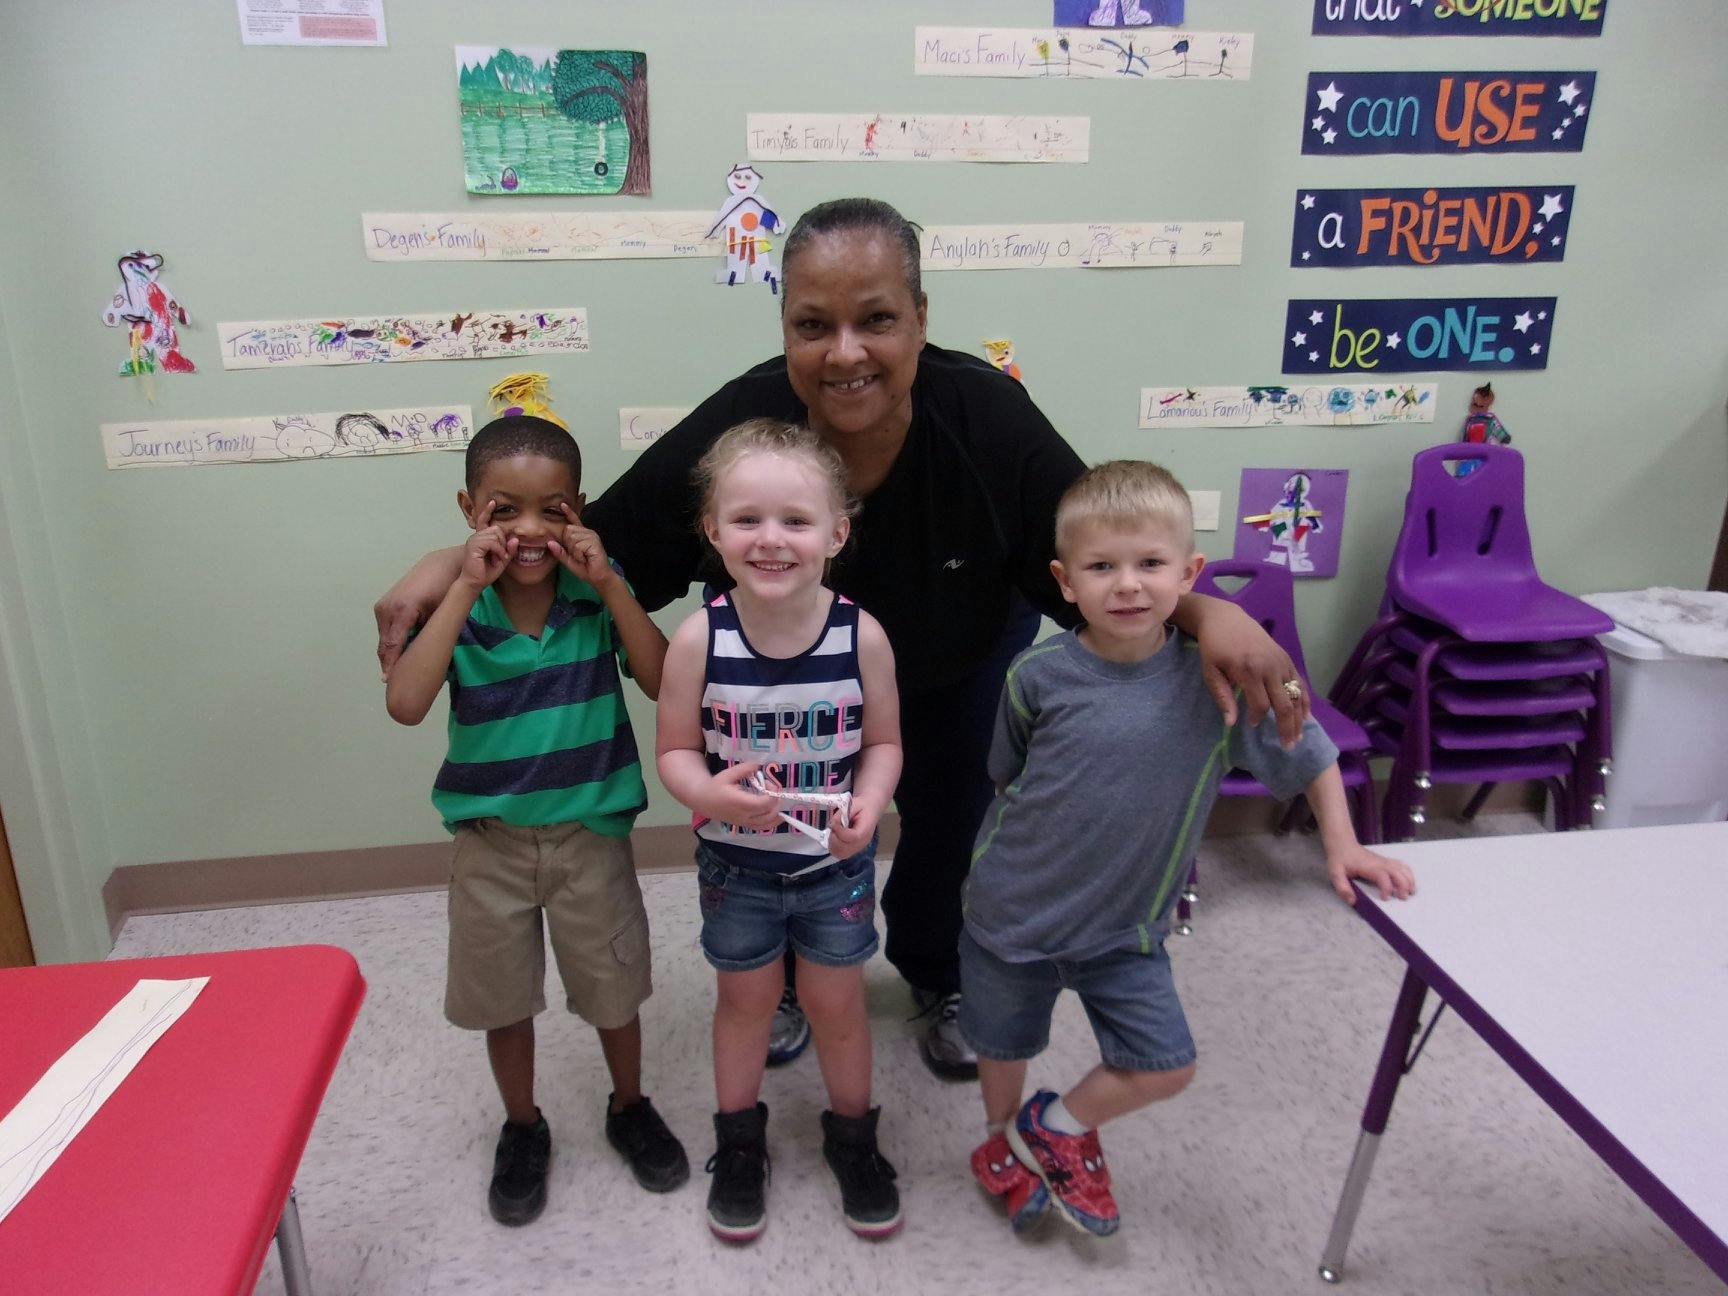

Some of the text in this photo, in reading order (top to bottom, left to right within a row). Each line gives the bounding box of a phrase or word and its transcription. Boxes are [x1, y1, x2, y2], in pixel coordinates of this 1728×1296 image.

[977, 33, 1027, 70] Family
[1346, 78, 1546, 149] can USE
[804, 124, 850, 154] Family
[437, 222, 486, 257] Family
[1318, 211, 1345, 250] a
[1004, 233, 1050, 267] Family
[1330, 304, 1515, 369] be ONE.
[1212, 400, 1253, 424] Family
[206, 431, 256, 460] Family
[709, 695, 865, 752] FIERCE
[727, 758, 843, 794] SIDE
